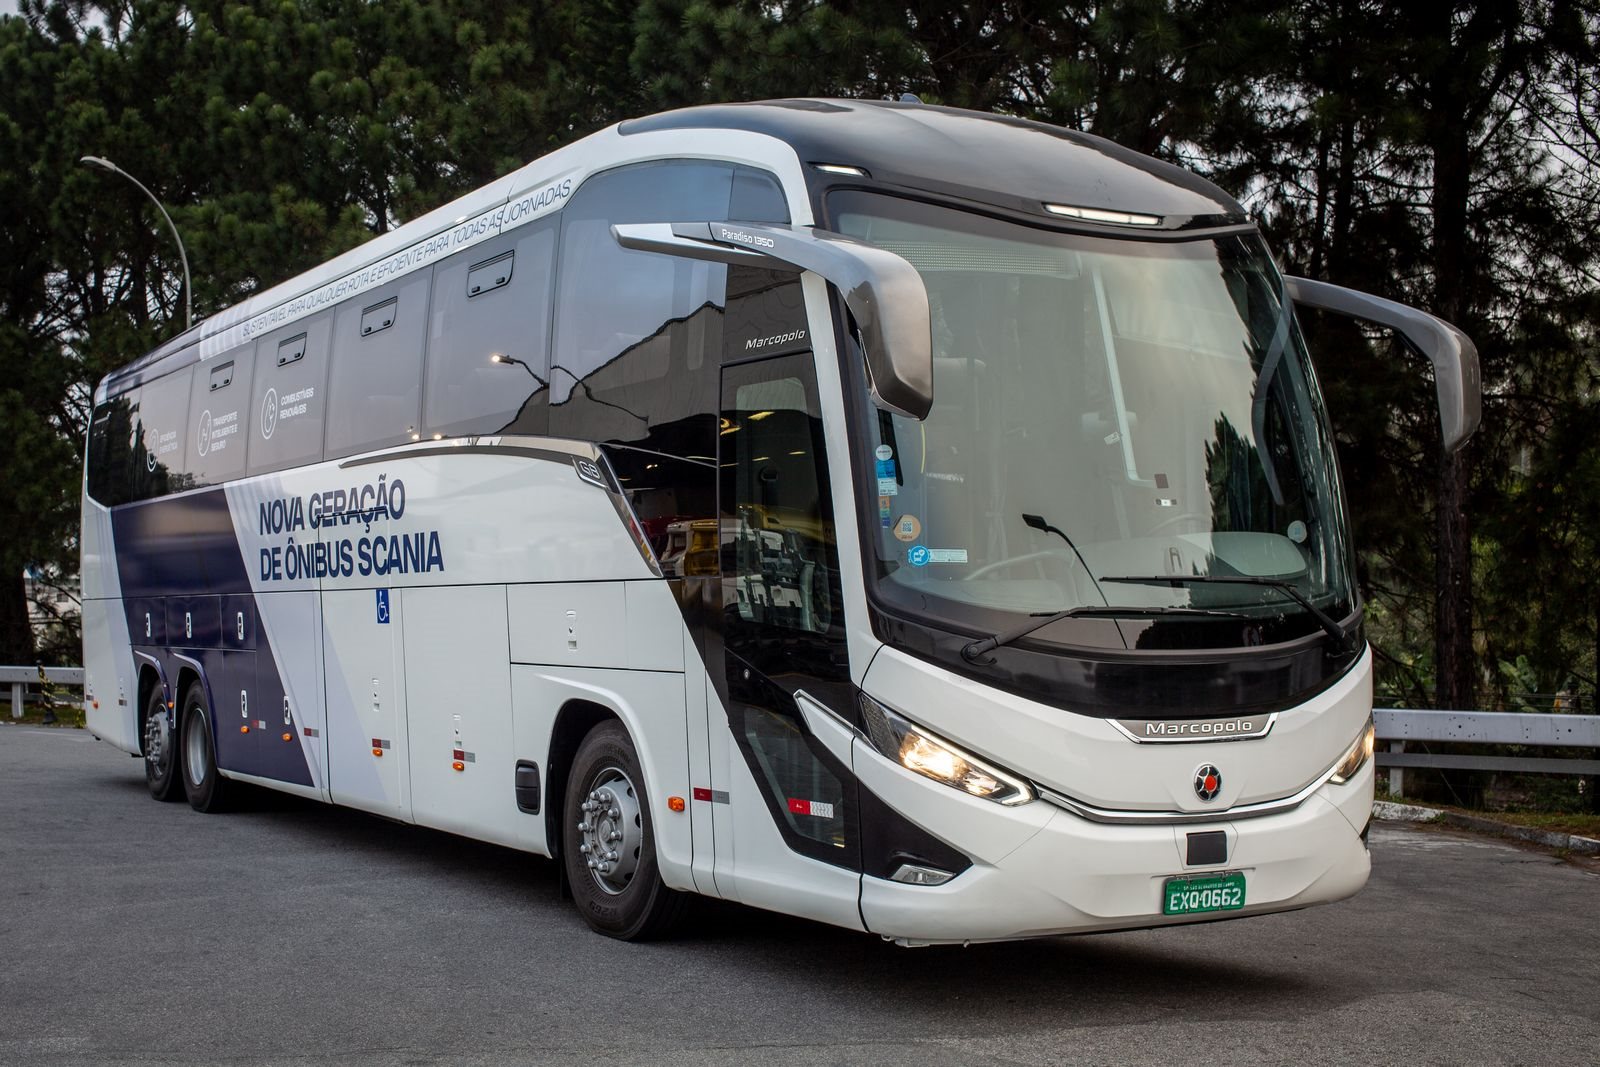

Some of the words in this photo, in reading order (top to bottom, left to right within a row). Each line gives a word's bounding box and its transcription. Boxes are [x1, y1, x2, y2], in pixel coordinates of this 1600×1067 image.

[306, 281, 348, 309] QUALQUER
[348, 271, 369, 291] ROTA
[370, 268, 377, 282] E
[377, 246, 425, 280] EFICIENTE
[424, 234, 450, 258] PARA
[452, 217, 488, 246] TODAS
[487, 210, 504, 228] AS
[504, 178, 571, 224] JORNADAS
[722, 228, 753, 244] Paradiso
[754, 235, 774, 248] 1350
[745, 329, 805, 350] Marcopolo
[259, 496, 305, 536] NOVA
[308, 473, 406, 533] GERAÇÃO
[260, 546, 282, 582] DE
[285, 537, 354, 581] ÔNIBUS
[357, 531, 445, 577] SCANIA
[1146, 719, 1252, 735] Marcopolo
